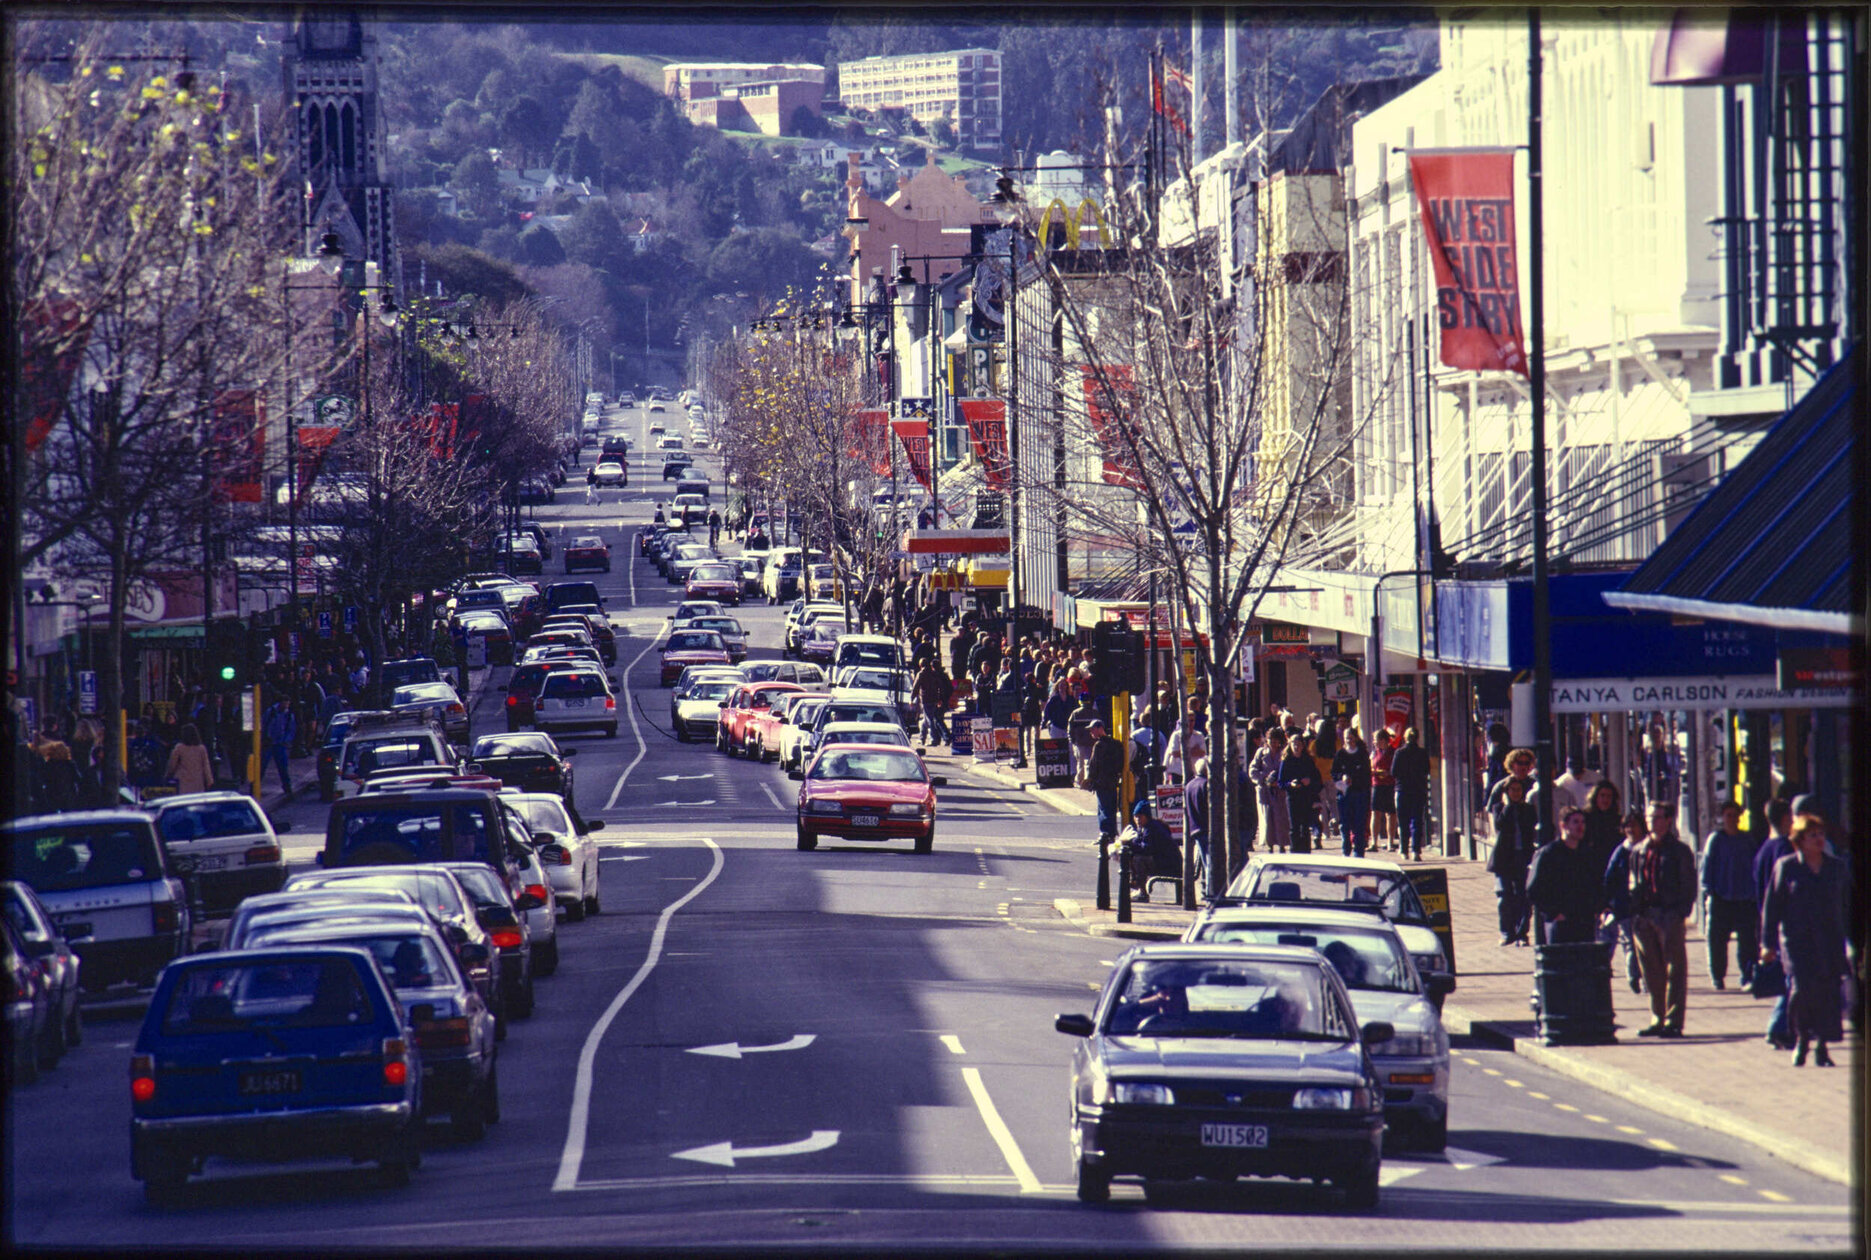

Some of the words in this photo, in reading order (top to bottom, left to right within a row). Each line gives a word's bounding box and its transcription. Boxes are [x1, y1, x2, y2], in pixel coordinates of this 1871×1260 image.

[1429, 197, 1512, 243] WEST
[1436, 286, 1517, 336] STRY
[1632, 685, 1728, 702] CARLSON
[1734, 688, 1796, 700] FASHION
[1038, 764, 1068, 777] OPEN
[1203, 1127, 1266, 1146] WU1502
